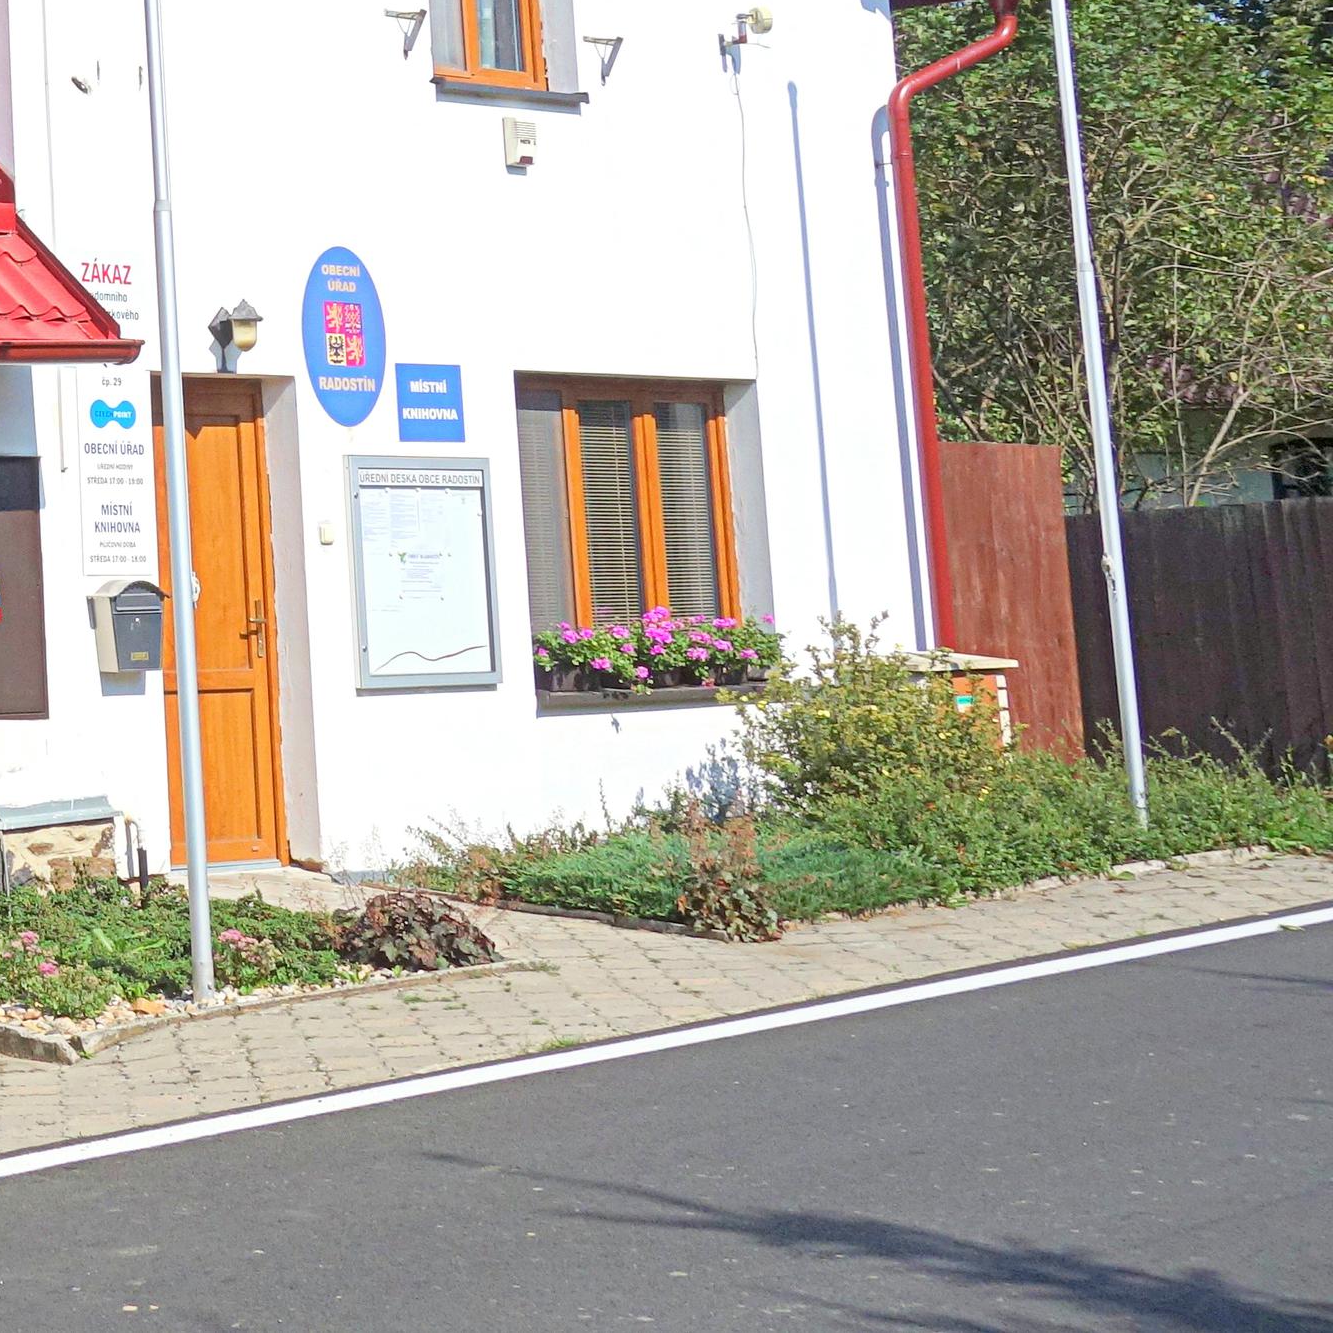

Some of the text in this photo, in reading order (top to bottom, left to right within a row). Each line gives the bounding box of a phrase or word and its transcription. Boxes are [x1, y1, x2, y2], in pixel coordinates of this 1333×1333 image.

[81, 257, 132, 285] ZÁKAZ
[321, 264, 361, 278] OBECNÍ
[327, 278, 357, 293] ÚŘAD
[91, 290, 128, 302] domního
[113, 377, 122, 386] 29
[318, 375, 376, 392] RADOSTÍN
[409, 378, 448, 394] MÍSTNÍ
[402, 408, 459, 421] KNIHOVNA
[84, 440, 145, 455] OBECNÍ ÚŘAD
[359, 471, 480, 484] ÚŘEDNÍ DESKA OBCE RADOSTÍN
[101, 501, 133, 516] MÍSTNÍ
[94, 521, 141, 533] KNIHOVNA
